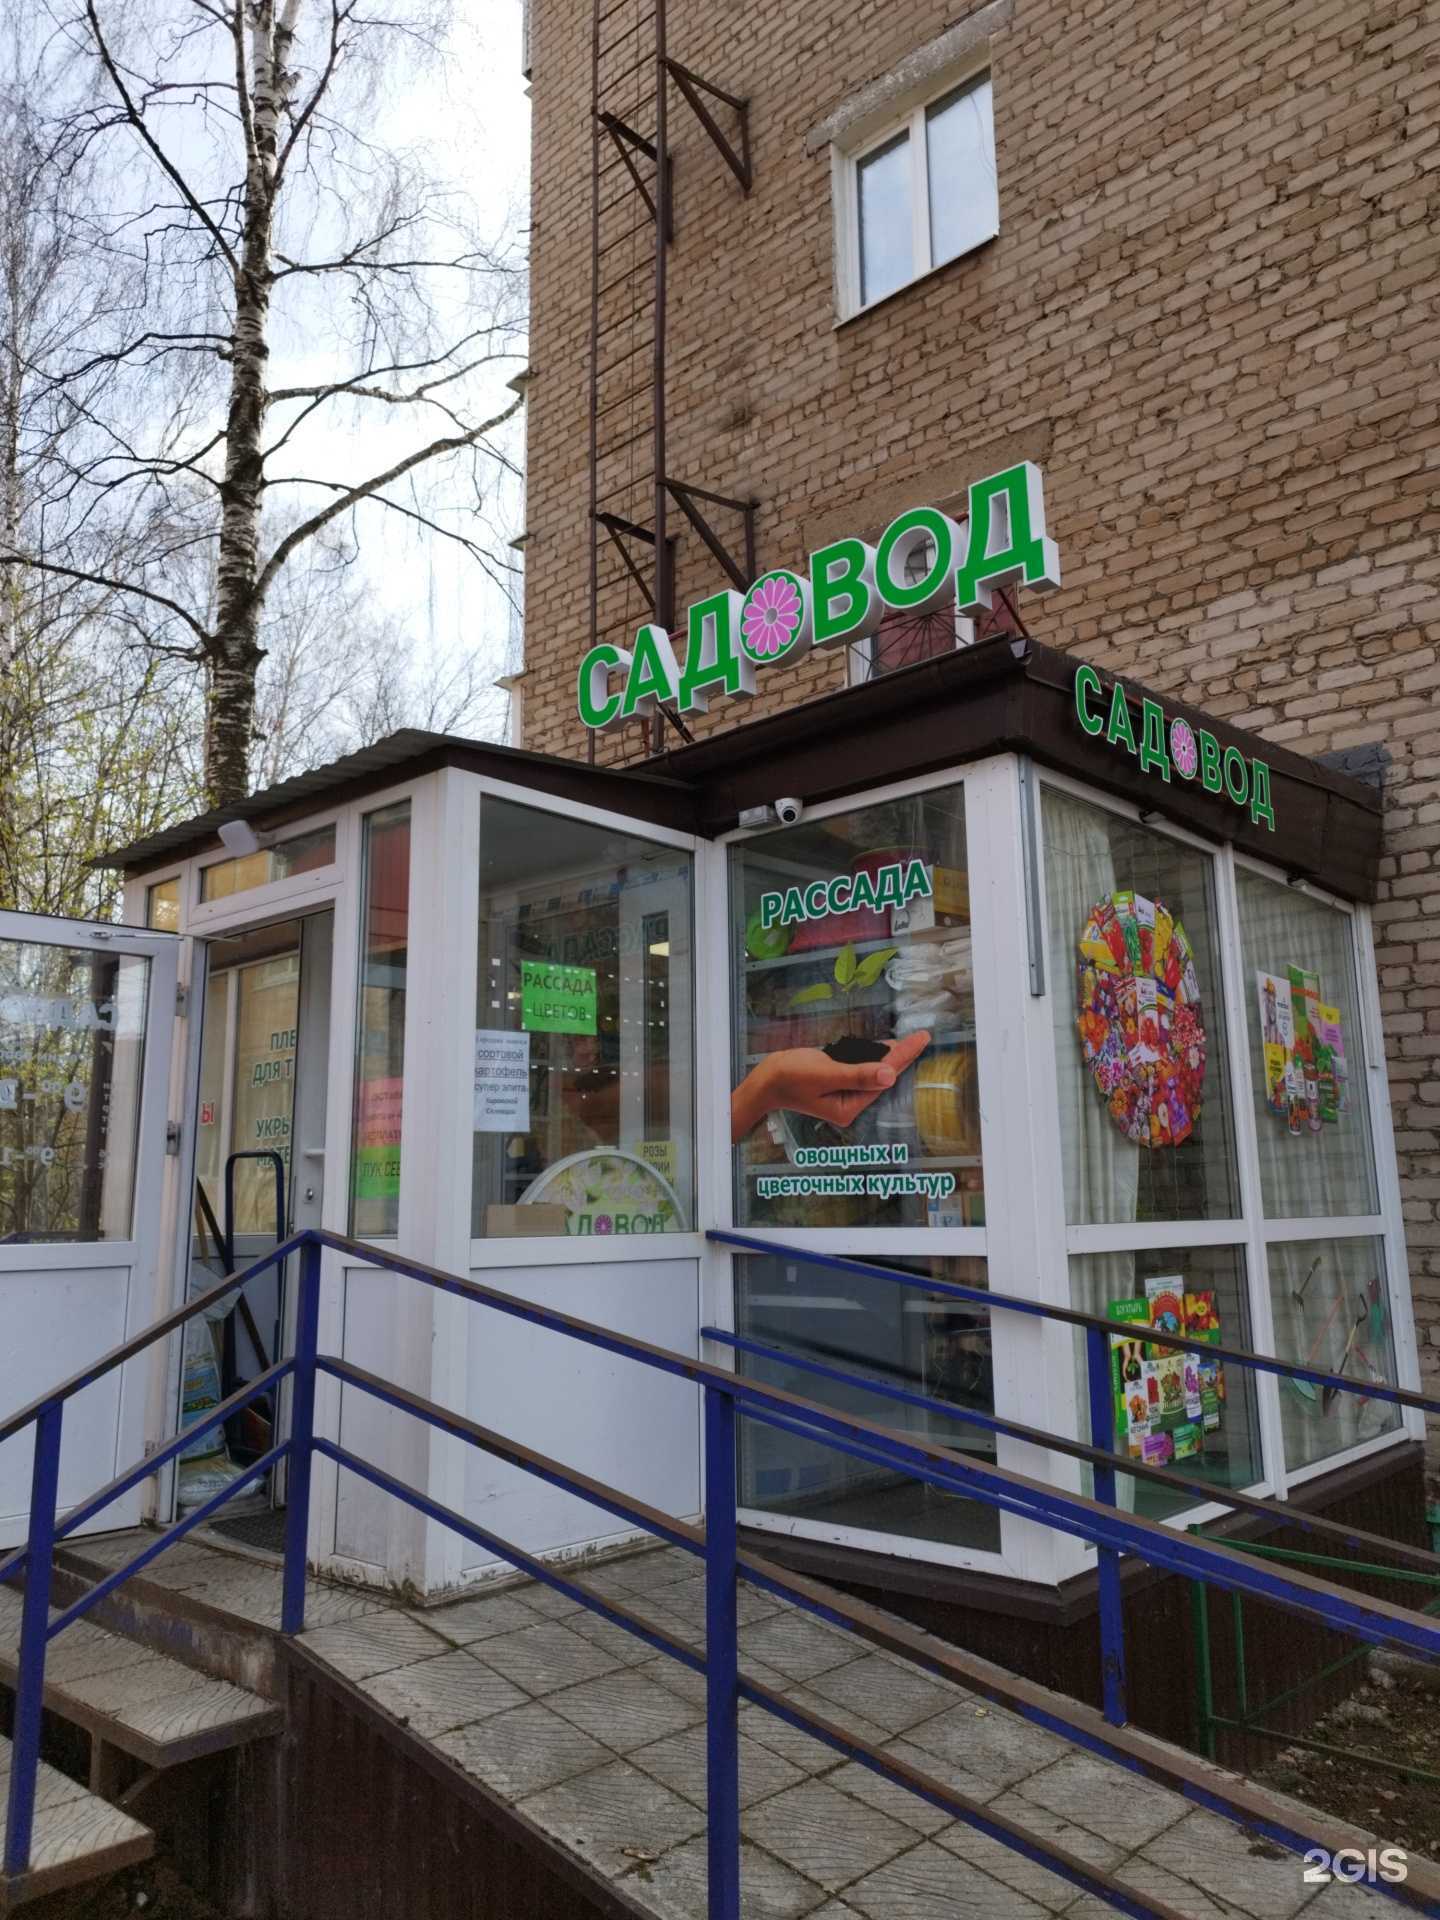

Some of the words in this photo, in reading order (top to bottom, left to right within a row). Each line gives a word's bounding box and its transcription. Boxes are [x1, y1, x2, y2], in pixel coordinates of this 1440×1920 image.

[577, 461, 1060, 730] САДОВОД
[1074, 664, 1276, 831] САДОВОД
[761, 859, 932, 928] РАССАДА
[524, 973, 593, 996] РАССАДА
[532, 1002, 586, 1021] ЦВЕТОВ
[252, 1061, 281, 1085] ДЛЯ
[795, 1144, 888, 1168] овощных
[893, 1144, 907, 1162] и
[757, 1176, 865, 1198] цветочных
[867, 1173, 955, 1198] культур
